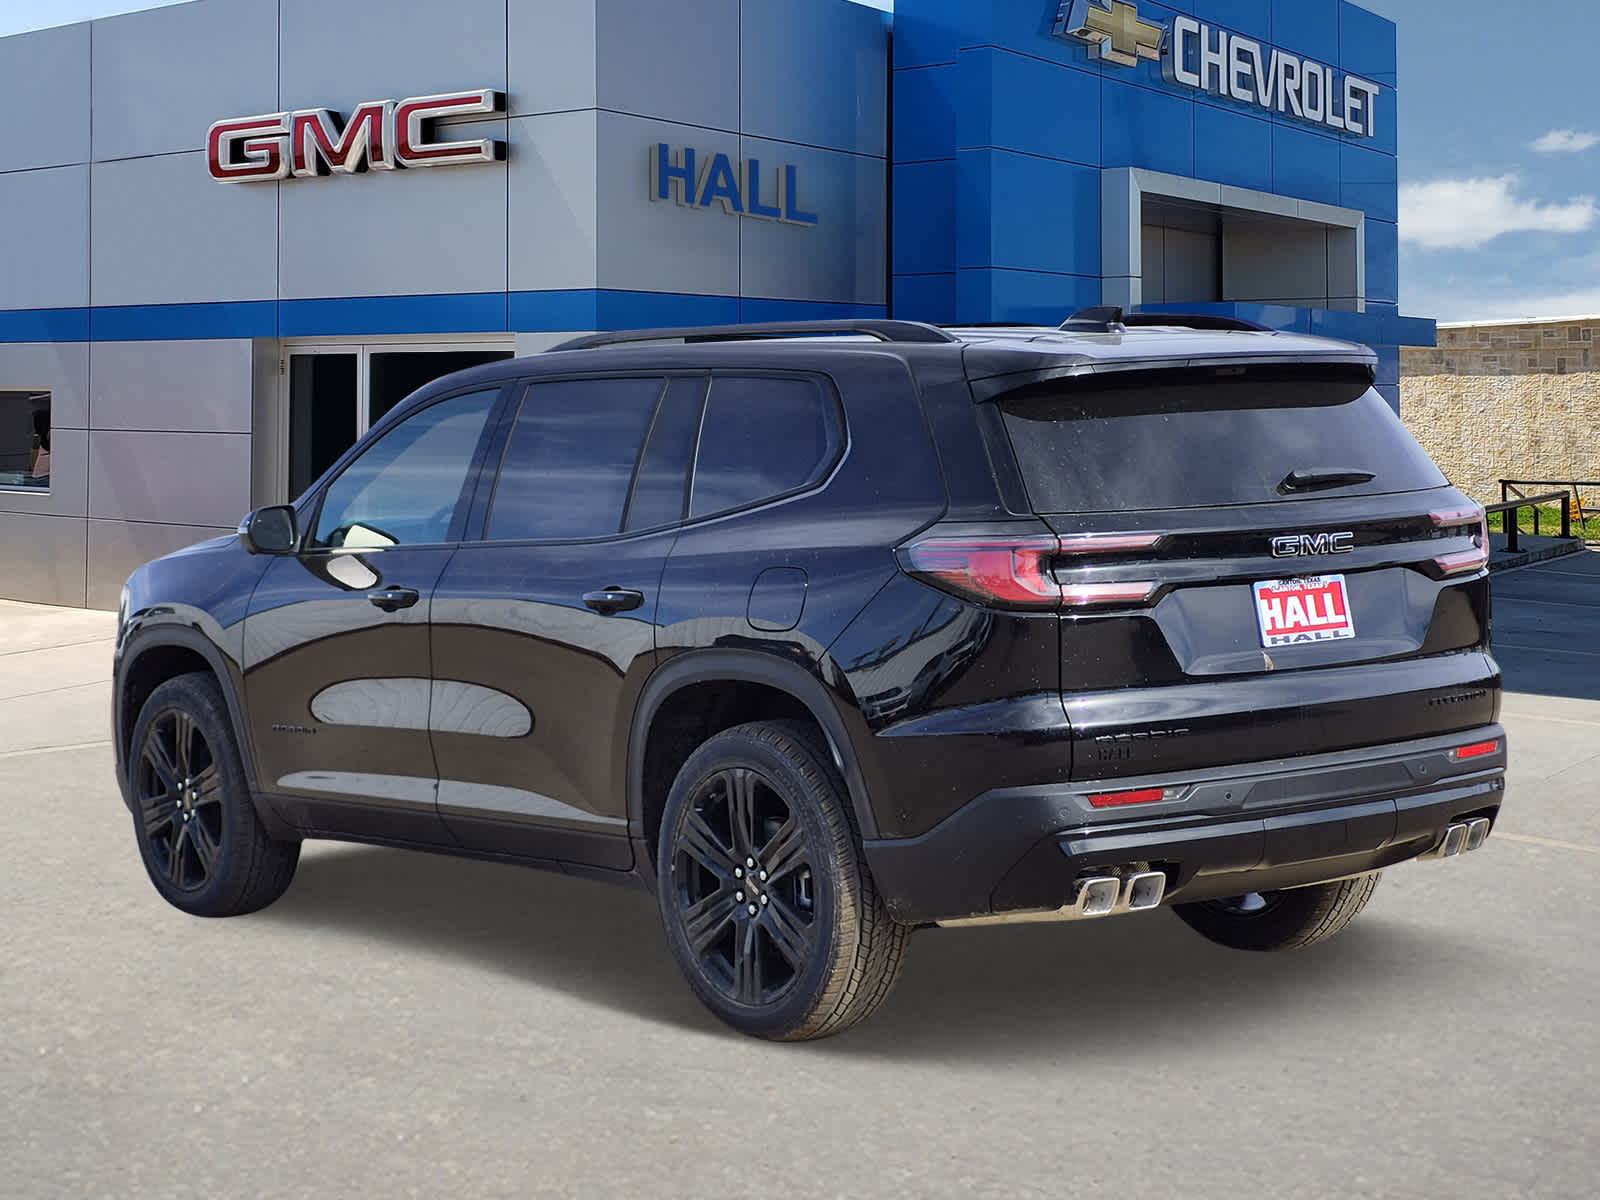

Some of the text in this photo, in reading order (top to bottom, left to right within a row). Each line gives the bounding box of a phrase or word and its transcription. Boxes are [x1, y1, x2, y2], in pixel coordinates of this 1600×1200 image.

[1174, 15, 1380, 137] CHEVROLET
[206, 88, 506, 184] GMC
[653, 142, 818, 226] HALL
[1272, 532, 1353, 557] GMC
[1260, 593, 1346, 630] HALL
[1270, 630, 1350, 645] HALL
